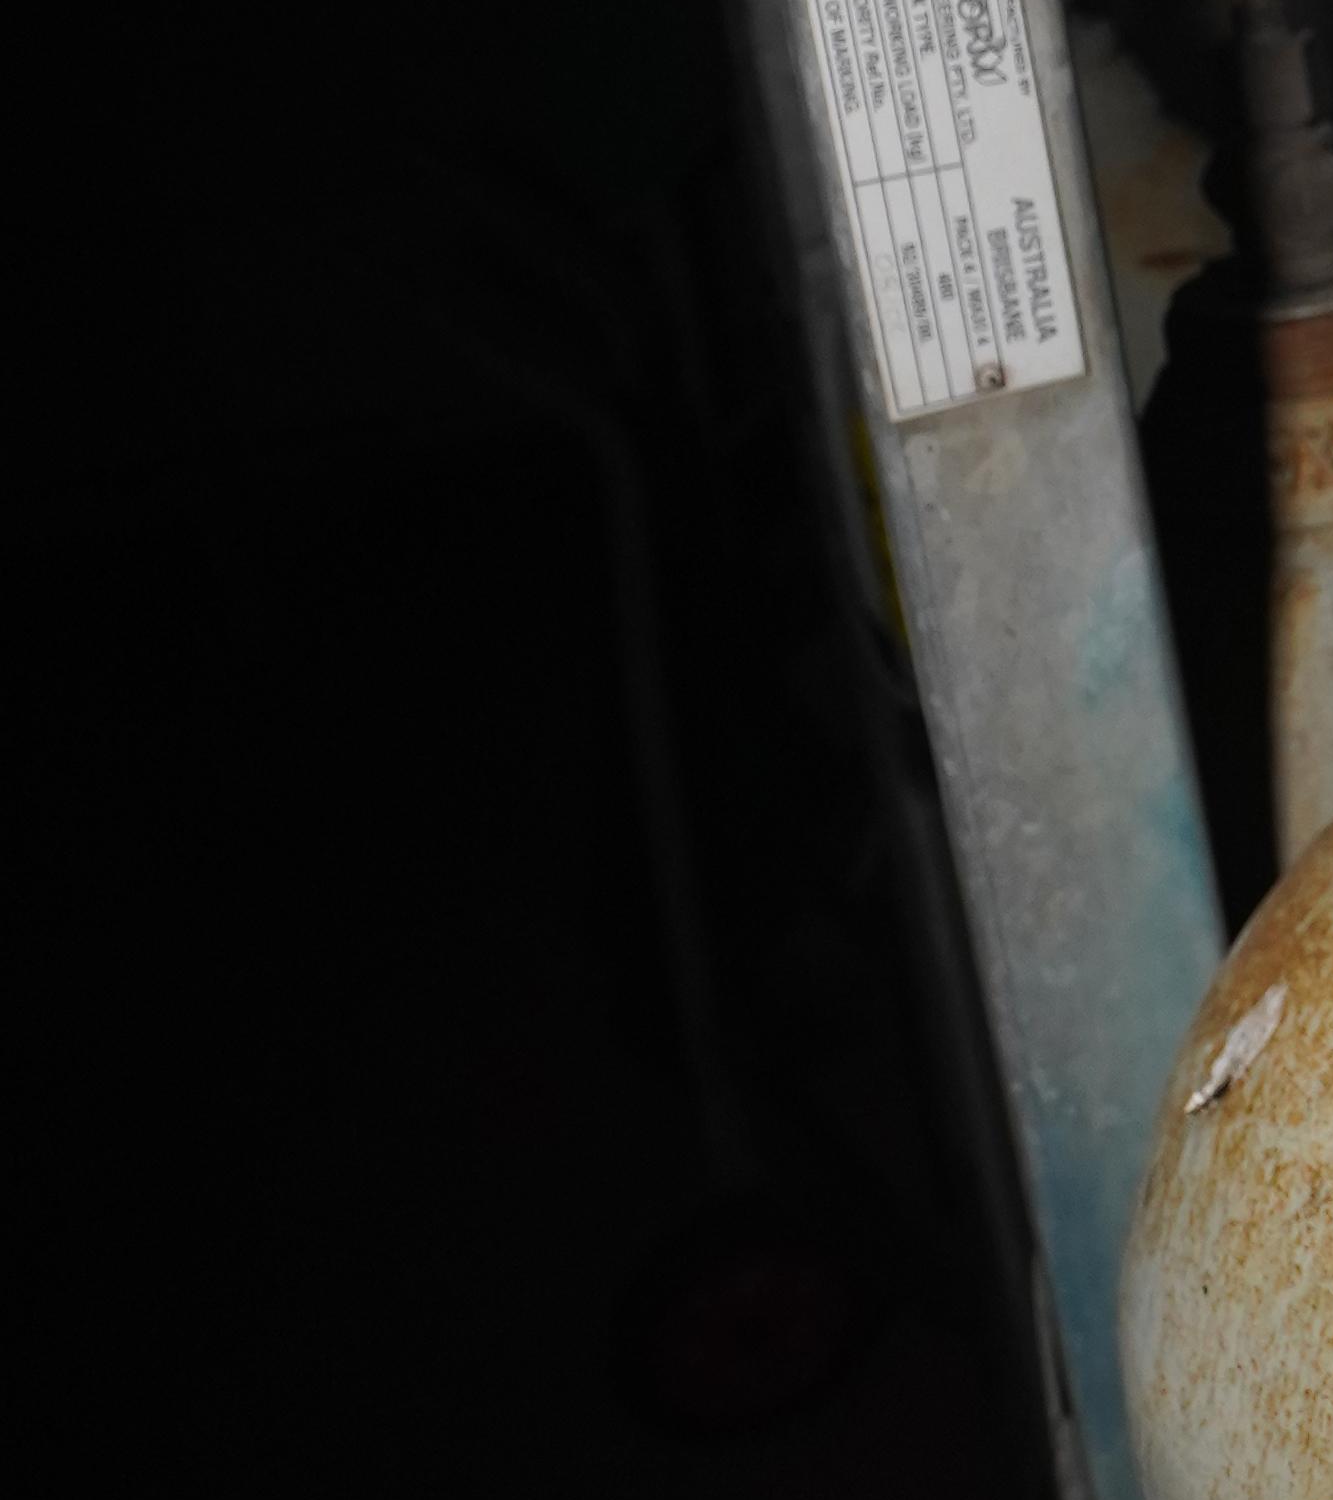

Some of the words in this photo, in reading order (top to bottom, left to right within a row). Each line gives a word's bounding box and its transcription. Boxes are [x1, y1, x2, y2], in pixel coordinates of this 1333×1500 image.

[828, 27, 861, 114] MARKING
[913, 11, 936, 57] TYPE
[897, 80, 921, 129] LOAD
[985, 226, 1026, 344] BRISBANE
[1010, 194, 1061, 345] AUSTRALIA
